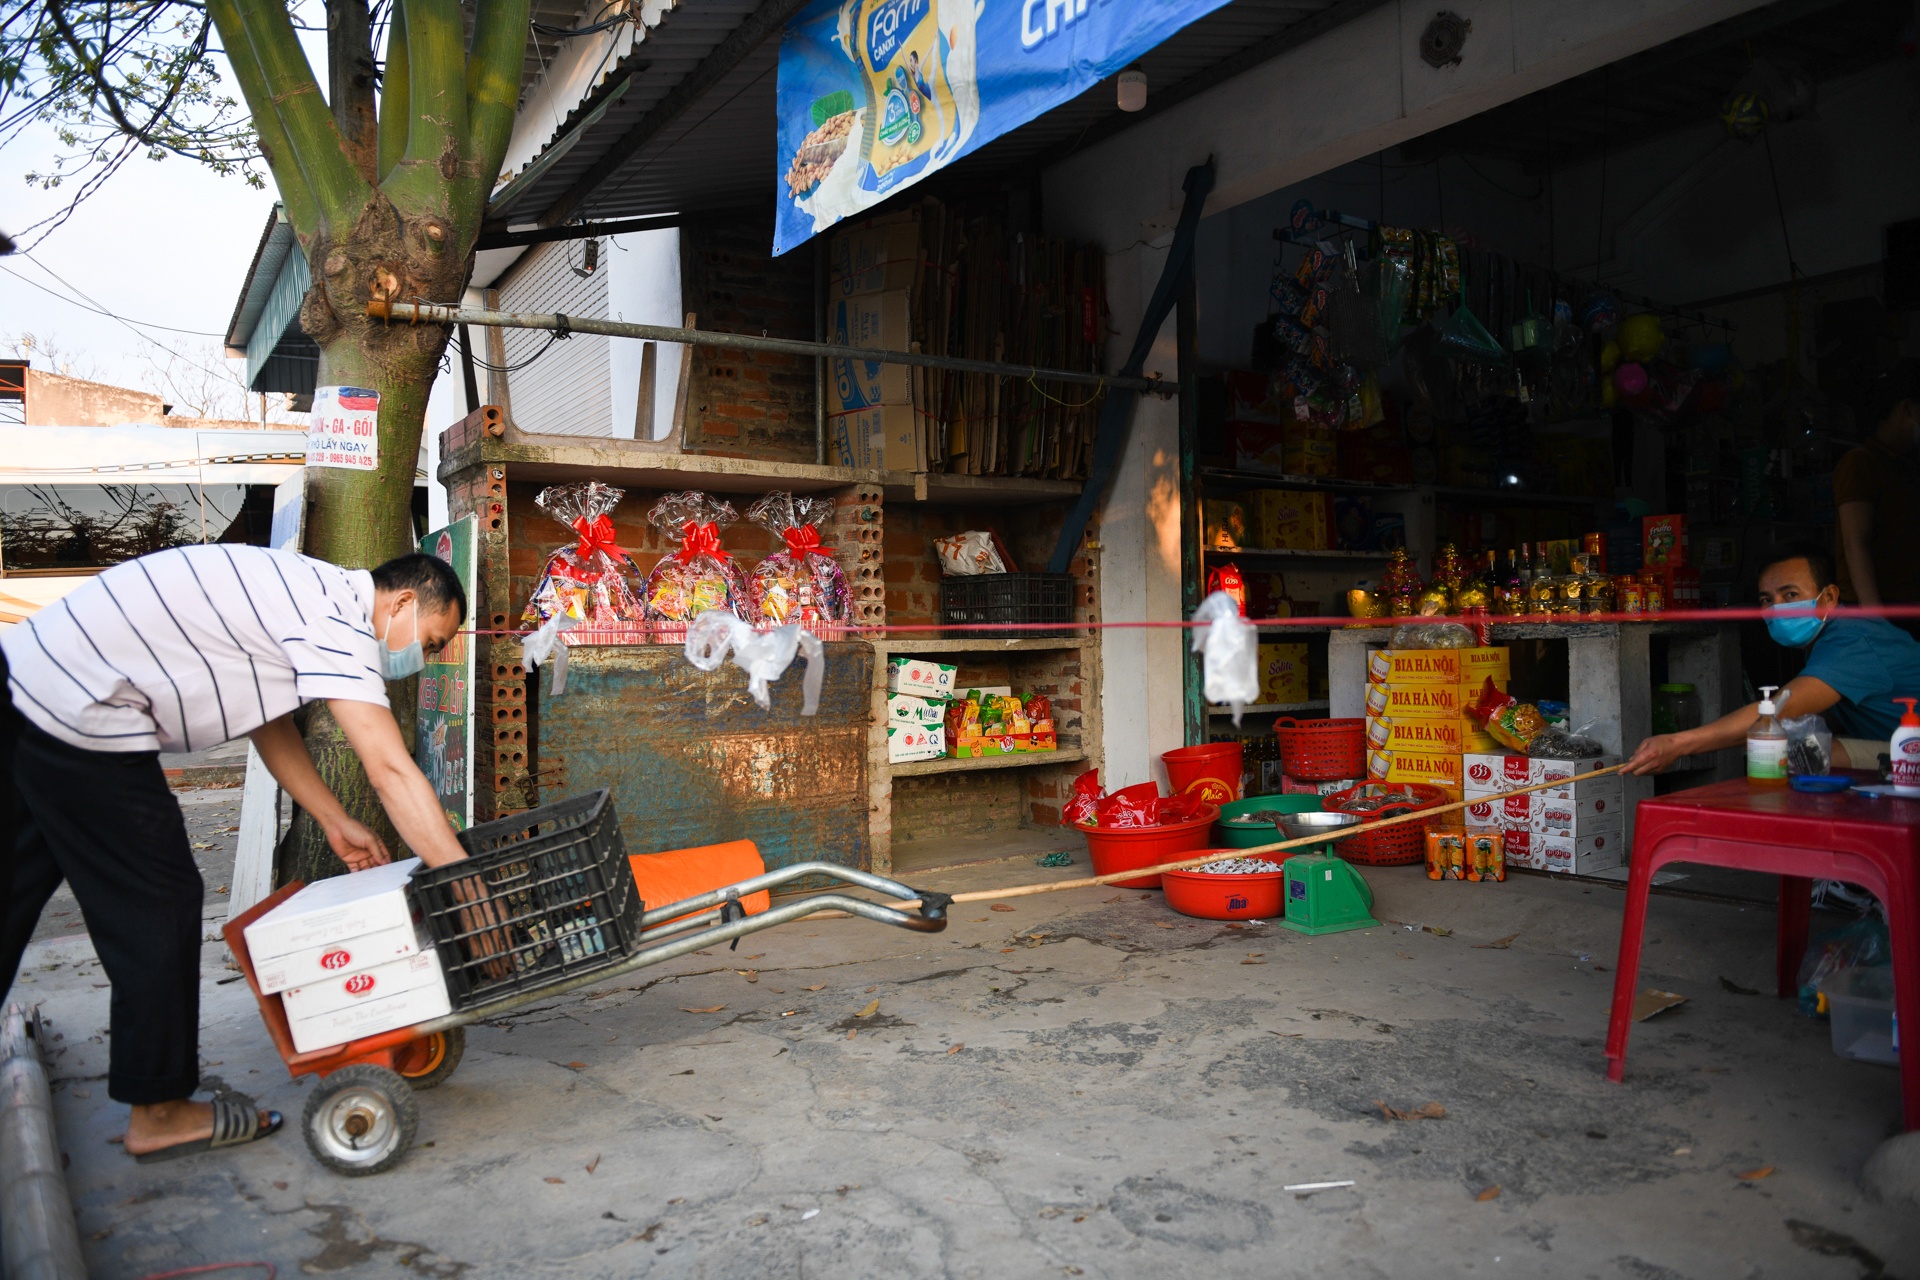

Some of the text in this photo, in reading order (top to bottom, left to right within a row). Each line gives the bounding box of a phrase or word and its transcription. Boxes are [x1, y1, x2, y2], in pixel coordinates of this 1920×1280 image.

[834, 329, 851, 400] ORO
[332, 418, 345, 434] GA
[353, 415, 373, 437] GỐI
[321, 437, 337, 449] LẤY
[340, 441, 368, 453] NGAY
[837, 415, 853, 467] OREO
[330, 453, 344, 463] 0965
[345, 454, 356, 465] 945
[359, 456, 372, 466] 425
[1278, 505, 1299, 521] Solite
[1395, 654, 1454, 675] BIA HÀ NỘI
[1471, 654, 1480, 663] BIA
[1481, 652, 1489, 662] HÀ
[1268, 660, 1293, 676] Solite
[418, 669, 465, 716] KEG 2 LÍT
[1392, 688, 1453, 710] BIA HÀ NỘI
[1394, 723, 1456, 744] BIA HÀ NỘI
[1396, 755, 1454, 777] BIA HÀ NỘI
[1473, 762, 1488, 778] 333
[1515, 761, 1519, 769] 3
[1473, 802, 1488, 815] 333
[1515, 799, 1519, 807] 3
[1229, 897, 1247, 909] Aba
